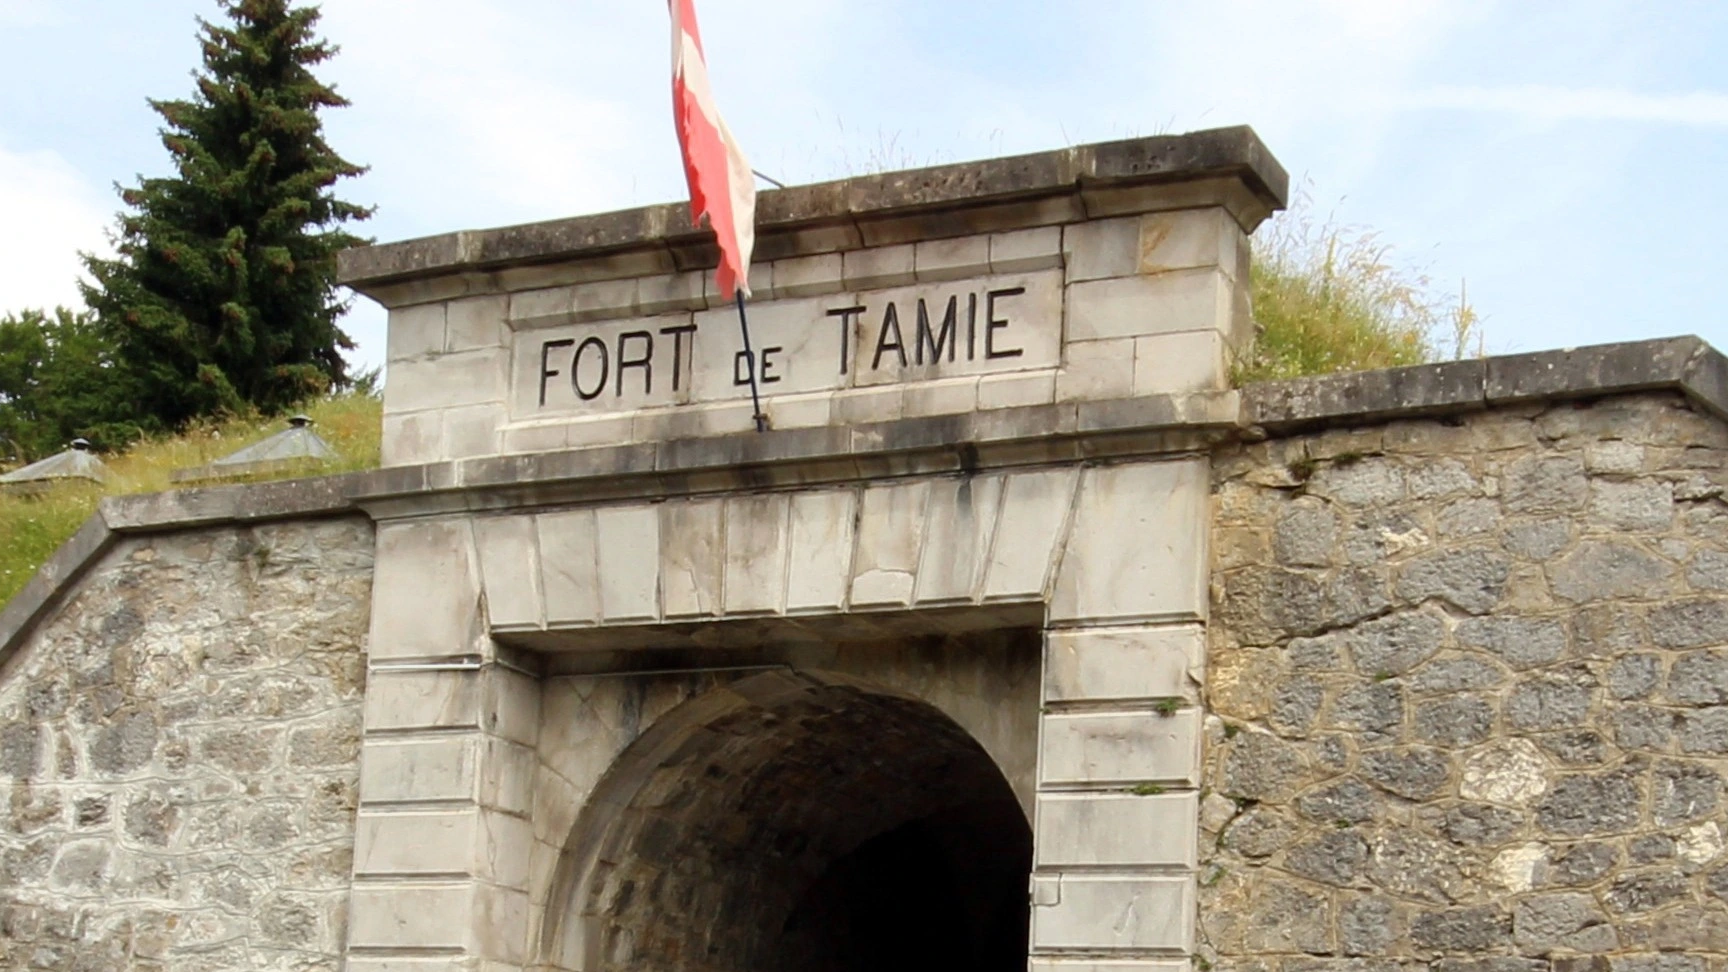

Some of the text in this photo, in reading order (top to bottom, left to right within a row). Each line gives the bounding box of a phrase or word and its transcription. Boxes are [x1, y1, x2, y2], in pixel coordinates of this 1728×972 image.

[539, 287, 1025, 407] FORT DE TAMIE
